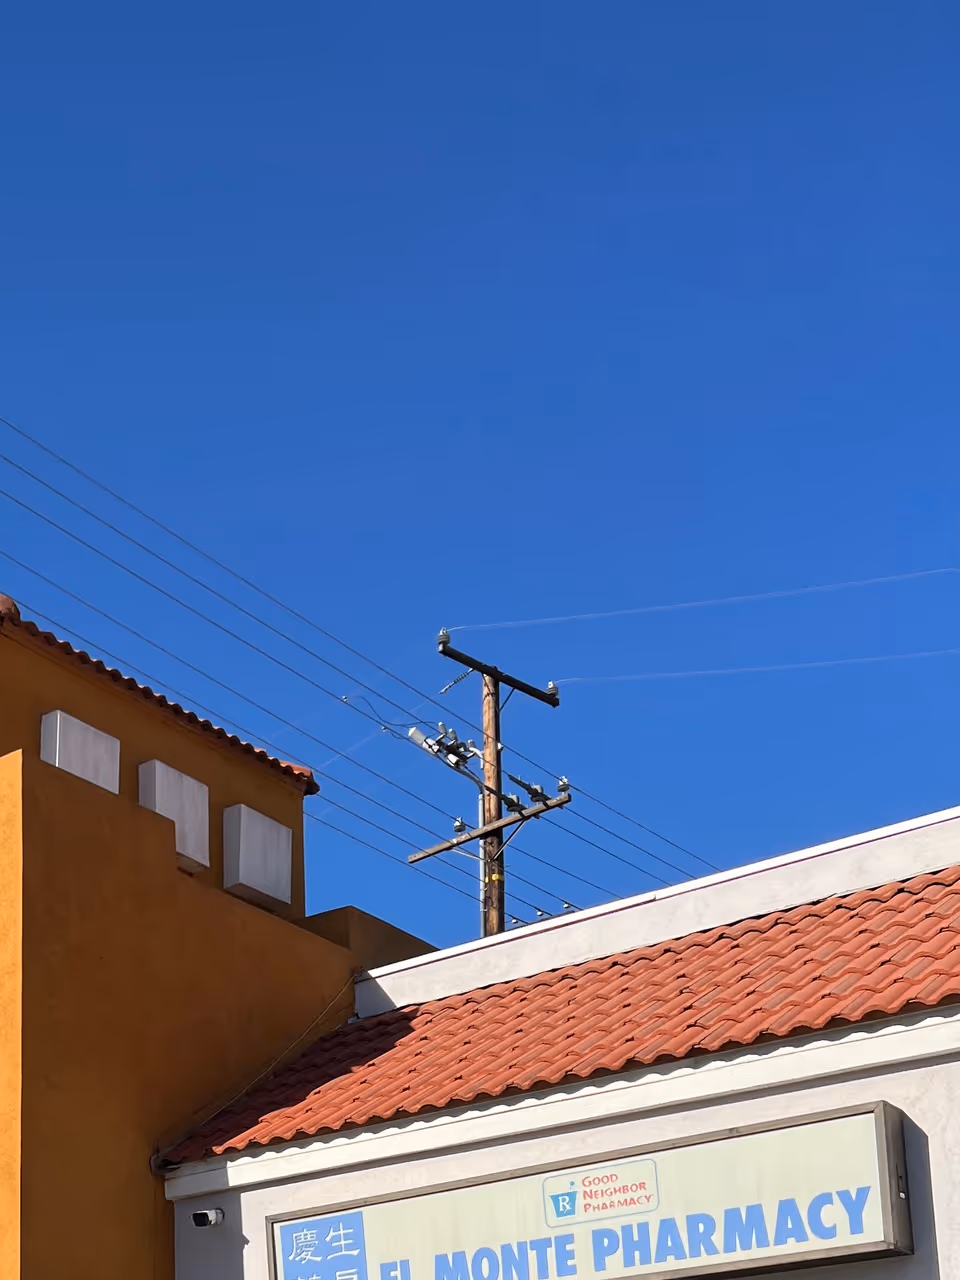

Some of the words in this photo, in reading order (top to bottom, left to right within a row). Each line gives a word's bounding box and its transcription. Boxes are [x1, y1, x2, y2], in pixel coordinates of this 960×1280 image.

[581, 1173, 618, 1187] GOOD
[583, 1182, 647, 1200] NEIGHBOR
[583, 1194, 652, 1213] PHARMACY
[591, 1186, 871, 1272] PHARMACY
